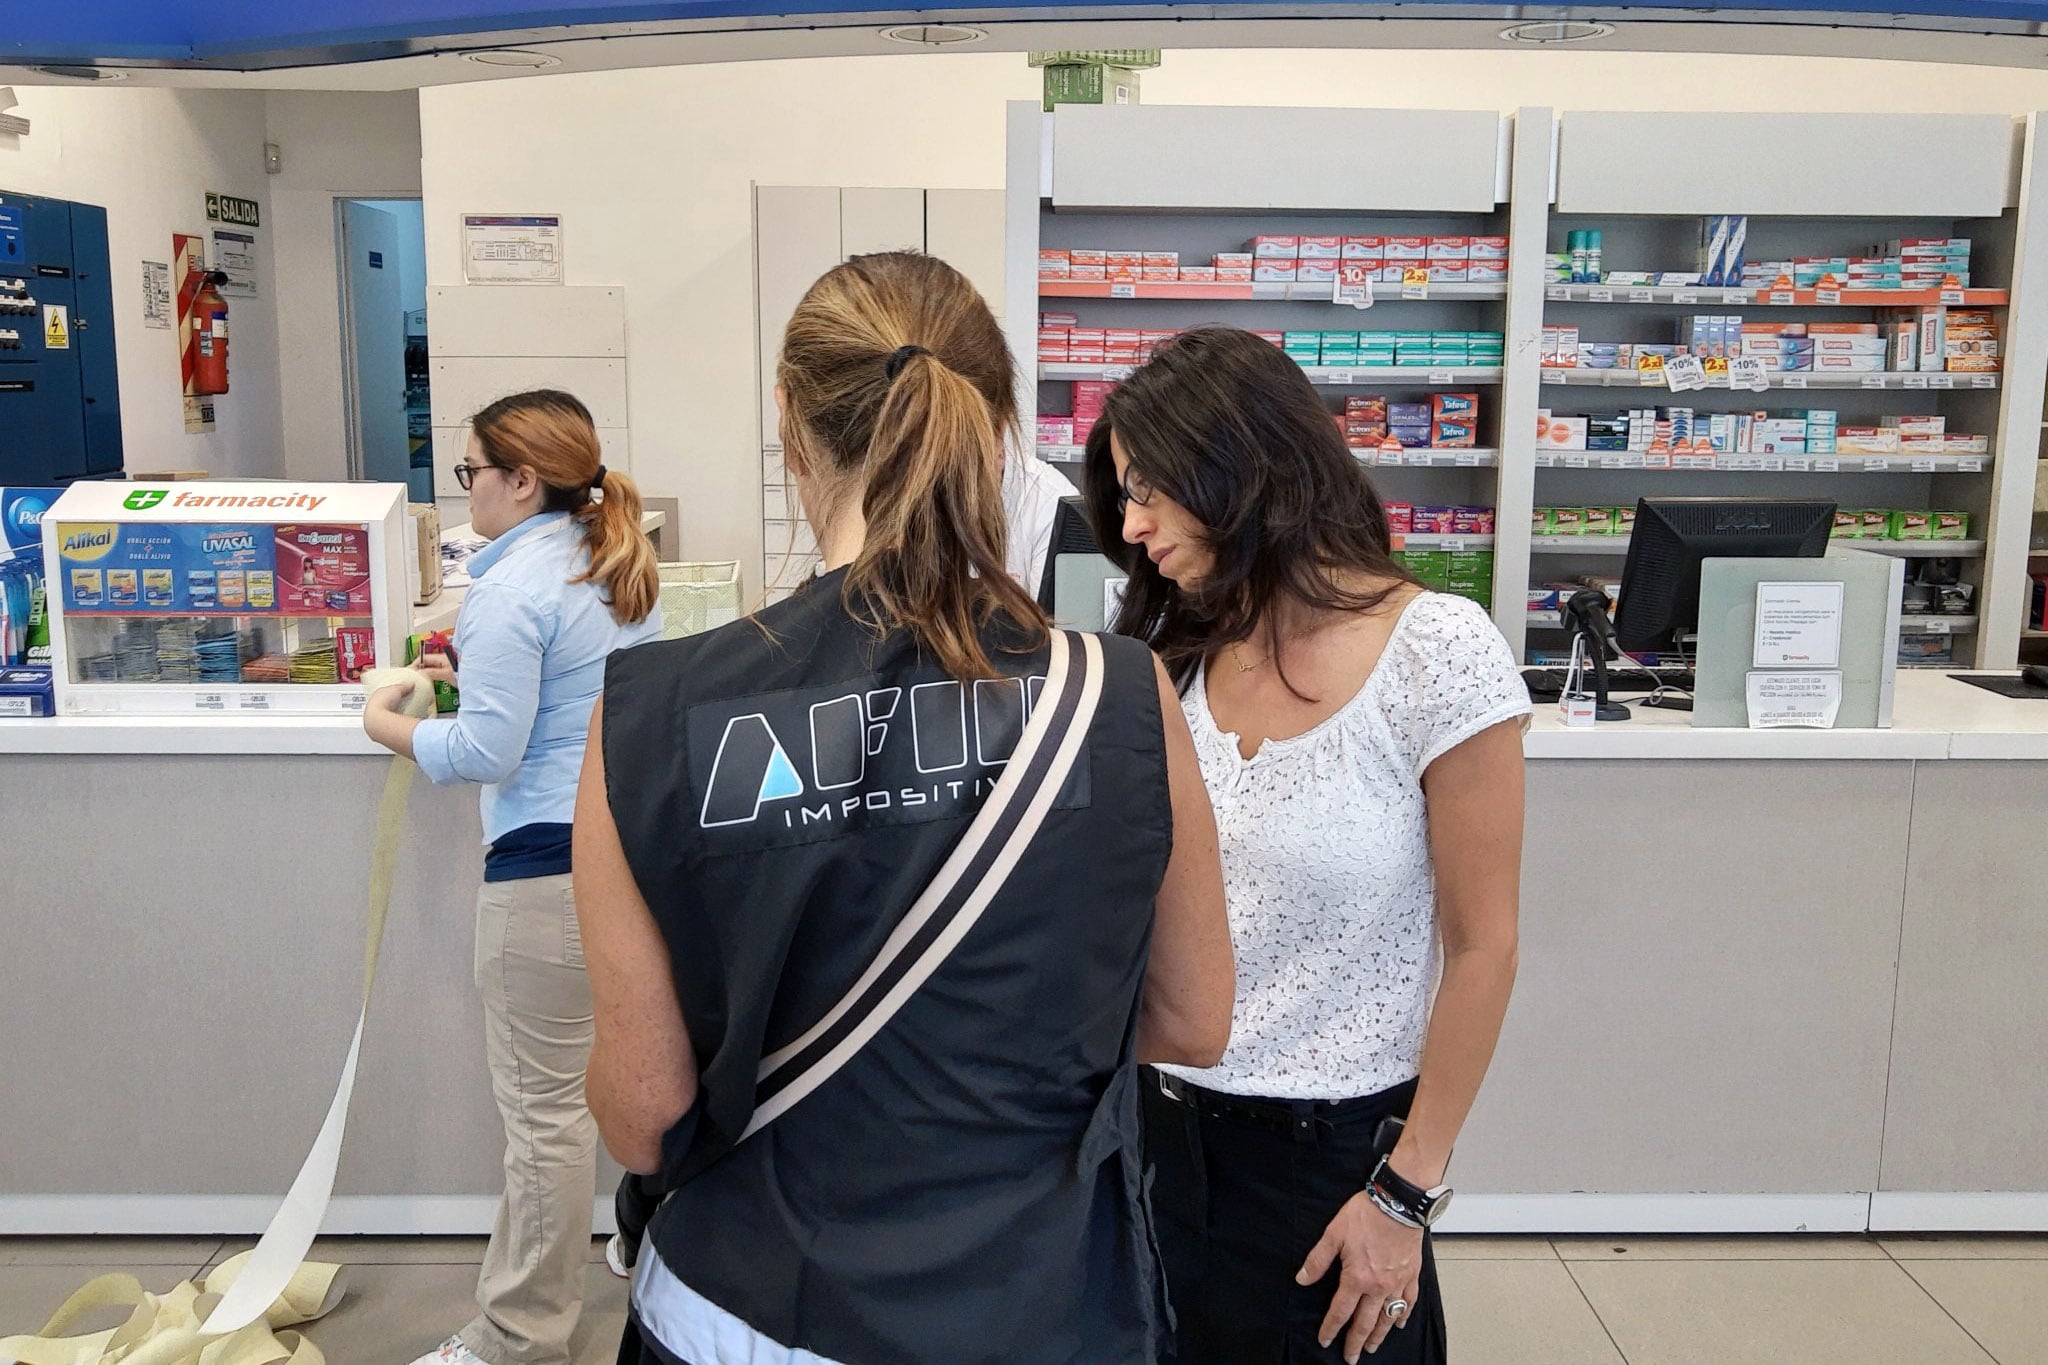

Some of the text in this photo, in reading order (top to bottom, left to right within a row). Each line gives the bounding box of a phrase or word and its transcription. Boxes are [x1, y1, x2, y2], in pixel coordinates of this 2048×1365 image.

[222, 198, 258, 224] SALIDA
[1669, 357, 1694, 371] -10%
[1733, 359, 1759, 369] -10%
[1444, 400, 1468, 410] Tafirol
[1442, 427, 1466, 436] Tafirol
[172, 491, 327, 511] farmacity
[202, 535, 256, 554] UVASAL
[322, 545, 342, 554] MAX
[27, 645, 52, 658] Gil
